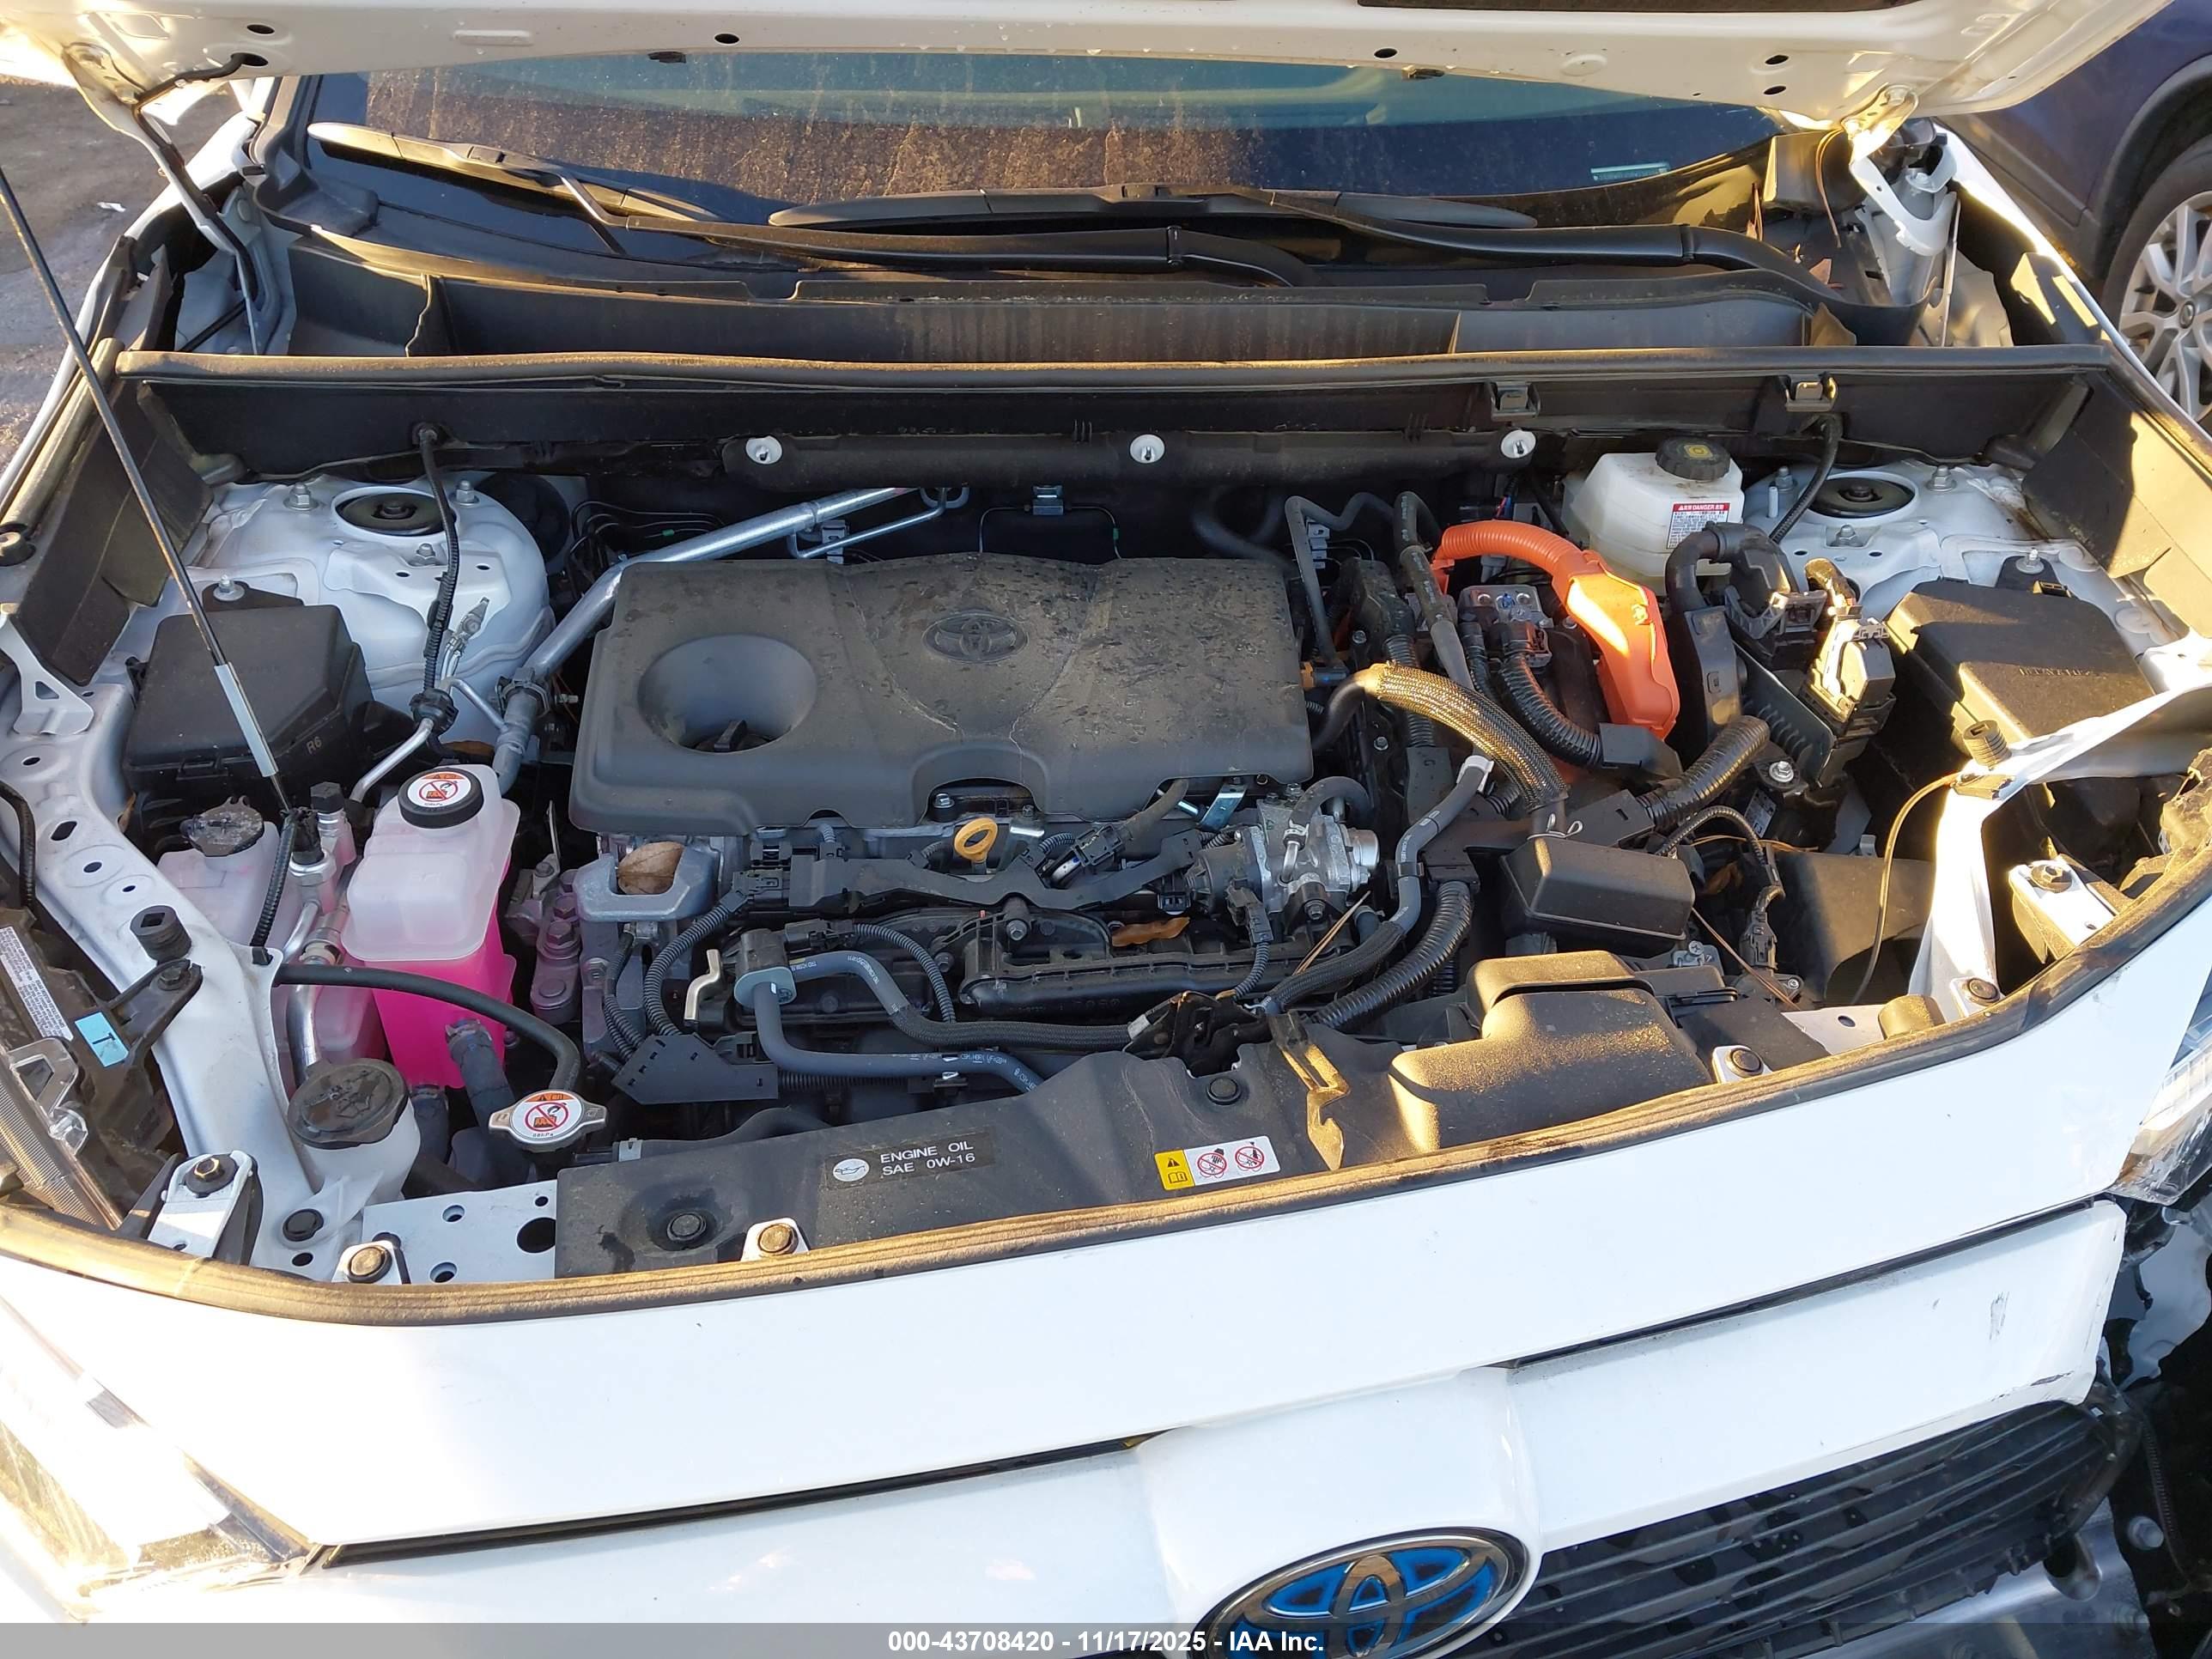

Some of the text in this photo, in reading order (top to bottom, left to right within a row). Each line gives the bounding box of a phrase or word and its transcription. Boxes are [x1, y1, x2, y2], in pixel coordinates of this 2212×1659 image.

[306, 736, 322, 755] R6
[880, 1140, 974, 1164] ENGINE OIL
[882, 1152, 975, 1176] SAE 0W-16
